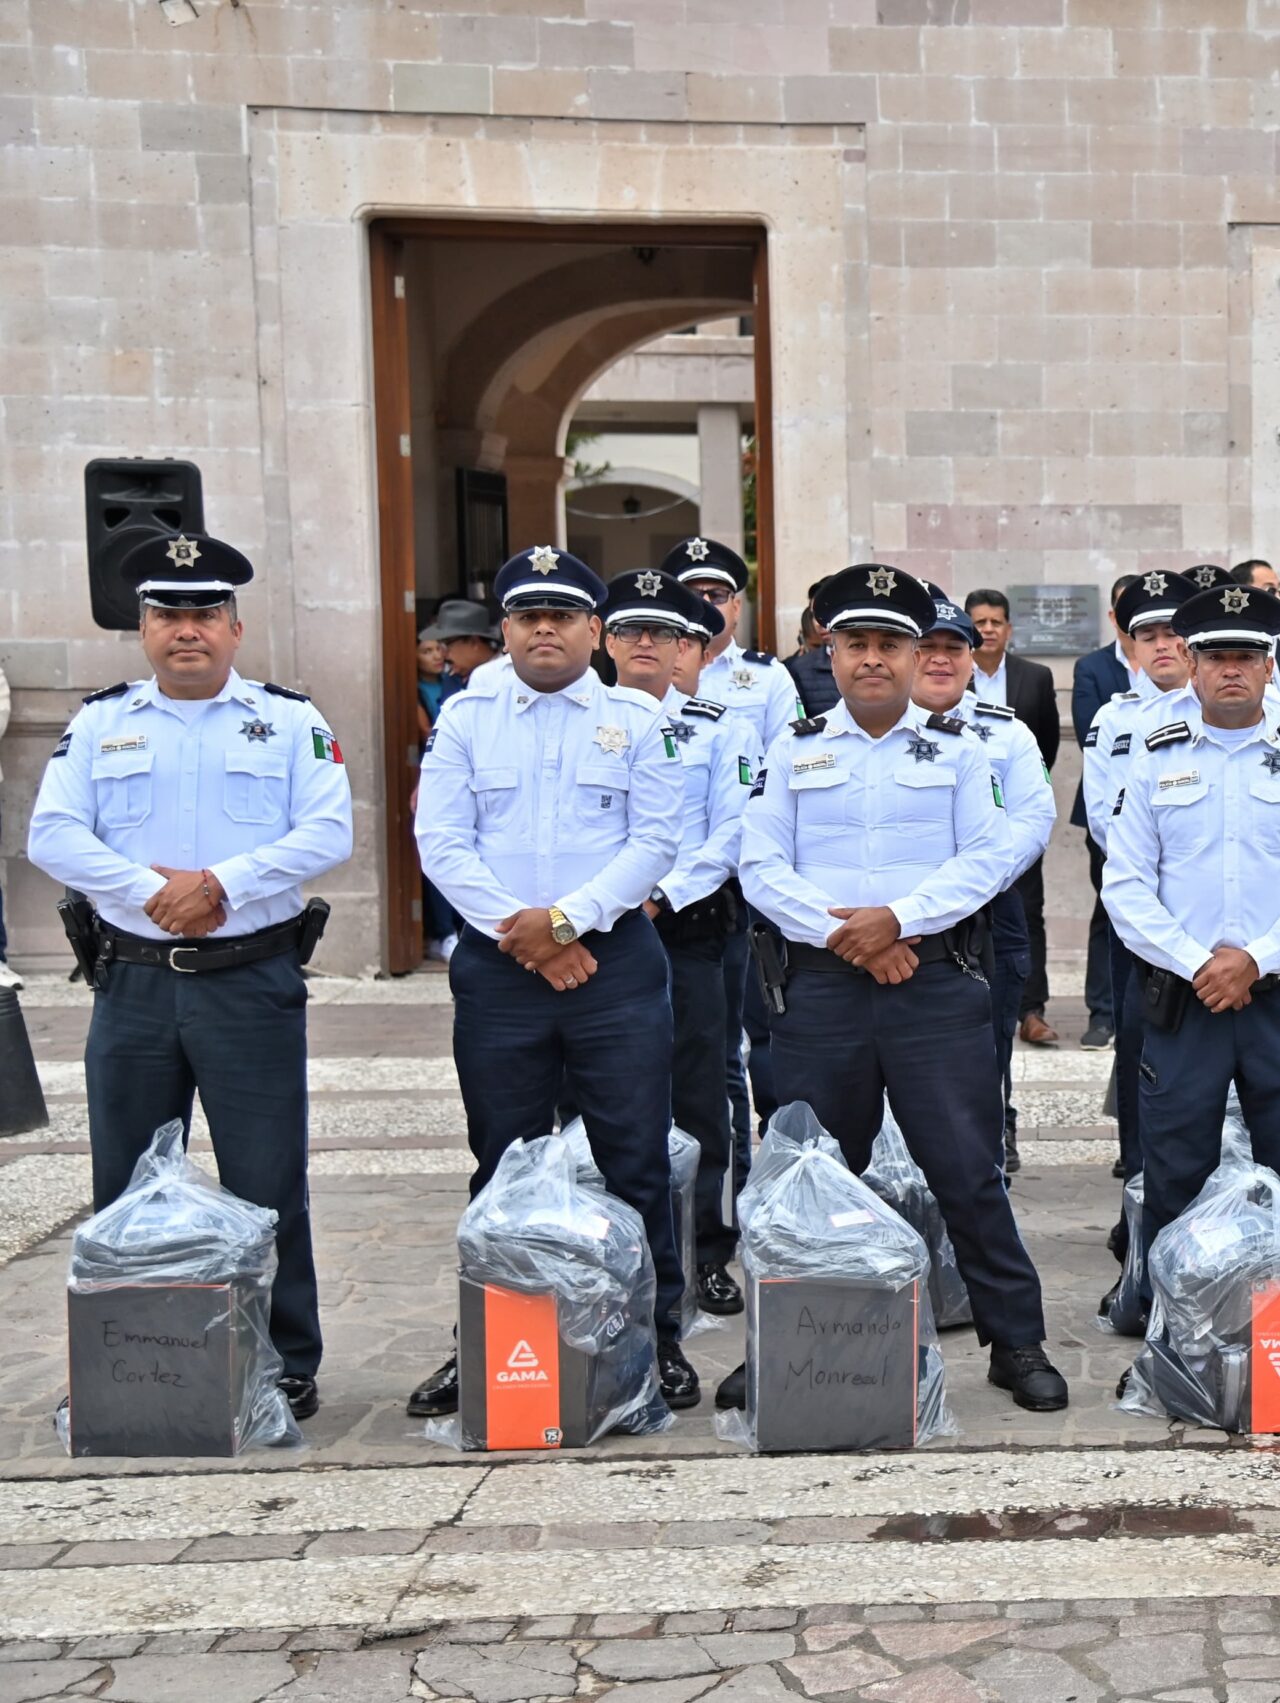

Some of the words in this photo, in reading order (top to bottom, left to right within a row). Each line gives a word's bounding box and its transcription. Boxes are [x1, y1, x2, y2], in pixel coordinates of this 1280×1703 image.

[101, 1319, 209, 1350] Emmanuel
[797, 1305, 901, 1335] Armando
[112, 1359, 190, 1388] Cortez
[496, 1370, 549, 1382] GAMA
[784, 1355, 888, 1391] Monreal
[546, 1431, 557, 1441] 75
